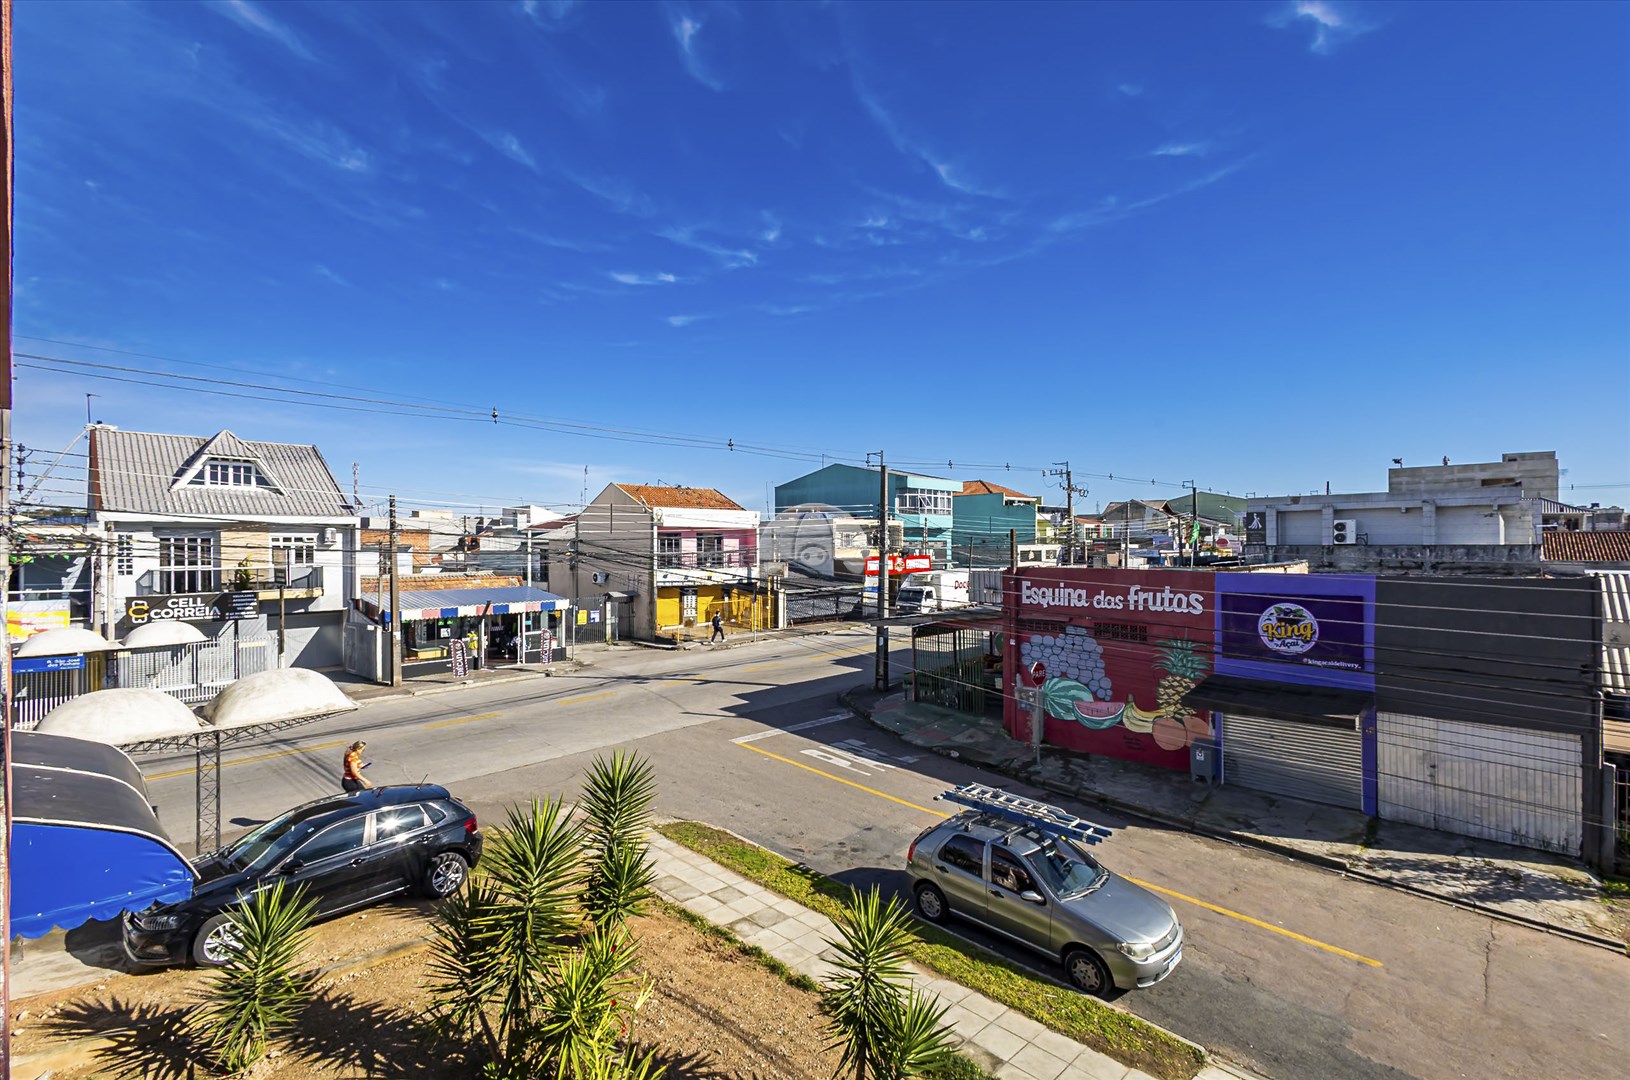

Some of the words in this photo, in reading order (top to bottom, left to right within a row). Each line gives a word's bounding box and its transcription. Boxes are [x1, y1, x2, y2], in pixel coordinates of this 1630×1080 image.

[167, 597, 206, 609] CELL
[1021, 581, 1089, 608] Esquina
[1093, 590, 1124, 609] das
[1127, 584, 1204, 615] frutas
[149, 606, 221, 619] CORREIA
[1262, 621, 1316, 642] King
[1031, 669, 1046, 678] PARE
